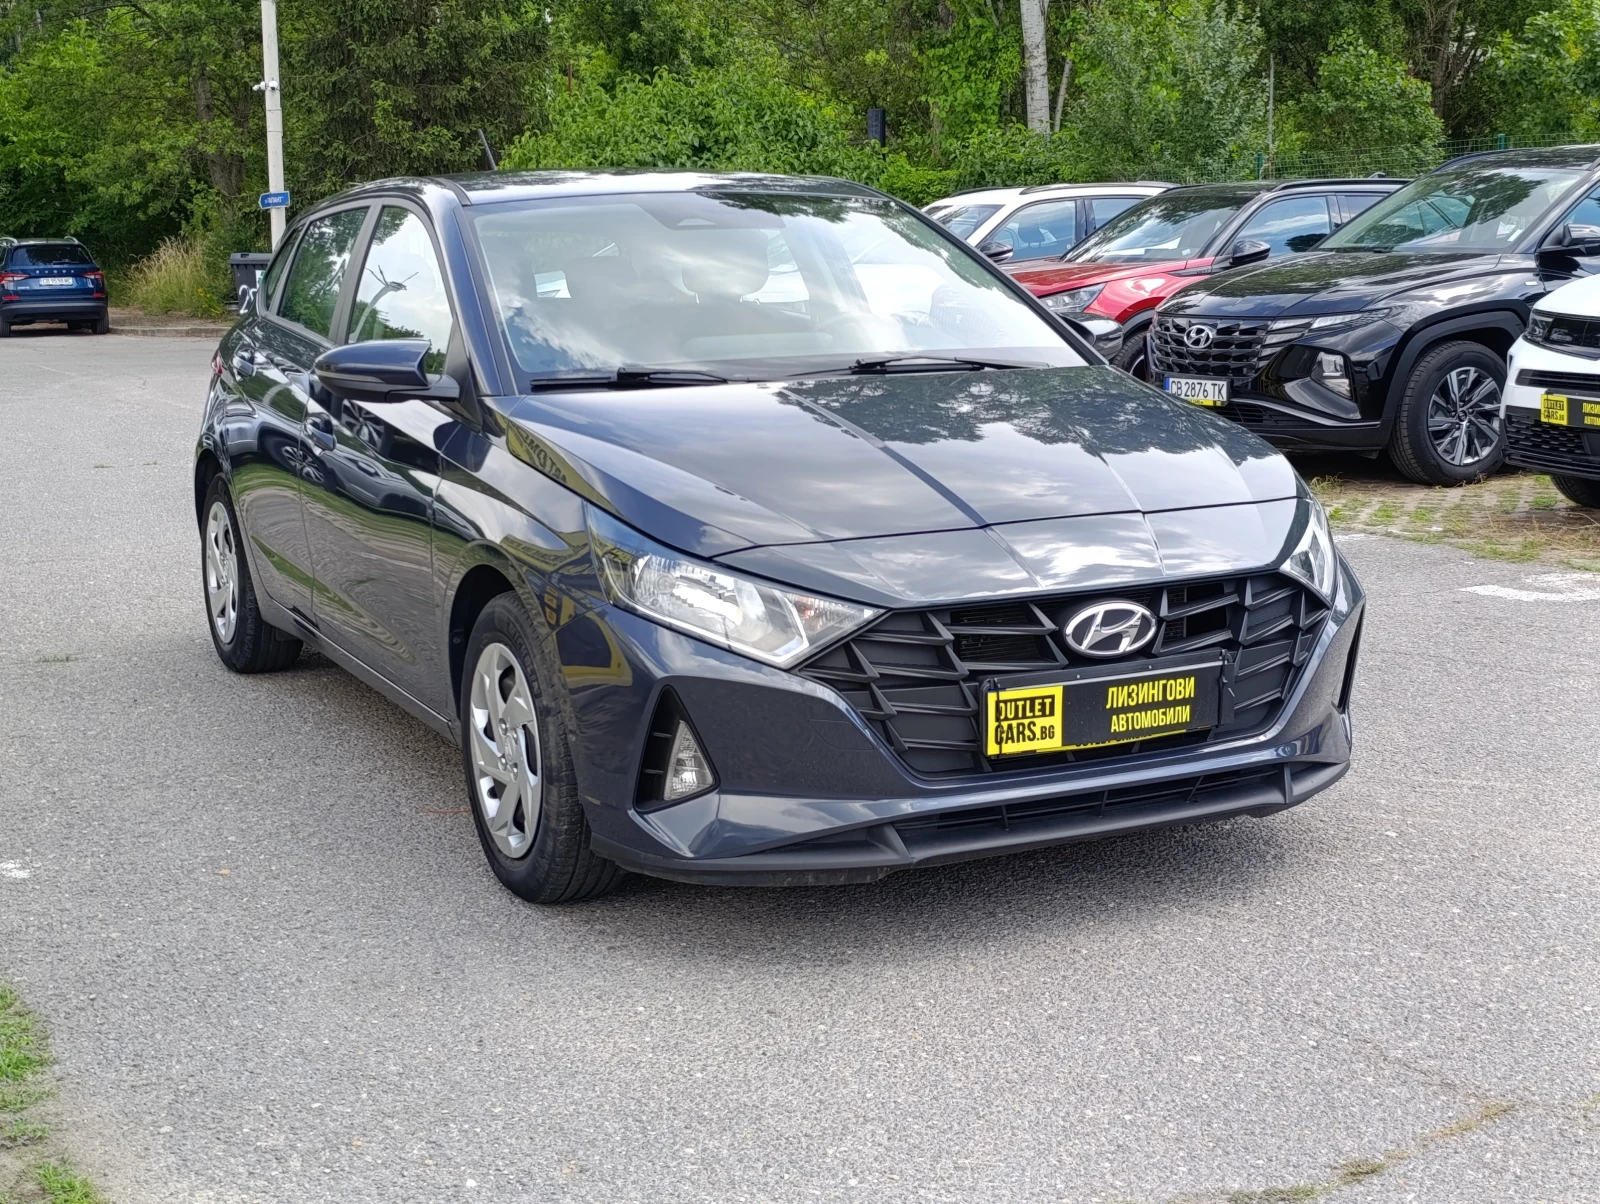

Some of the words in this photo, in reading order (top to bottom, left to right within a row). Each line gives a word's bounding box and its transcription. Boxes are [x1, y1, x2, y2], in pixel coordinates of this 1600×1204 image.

[1170, 380, 1183, 396] CB
[1184, 382, 1209, 398] 2876
[1211, 383, 1224, 399] TK
[1106, 677, 1195, 709] ЛИЗИНГОВИ
[997, 698, 1052, 719] OUTLET
[1110, 705, 1190, 732] АВТОМОБИЛИ
[995, 721, 1055, 745] CARS.BG
